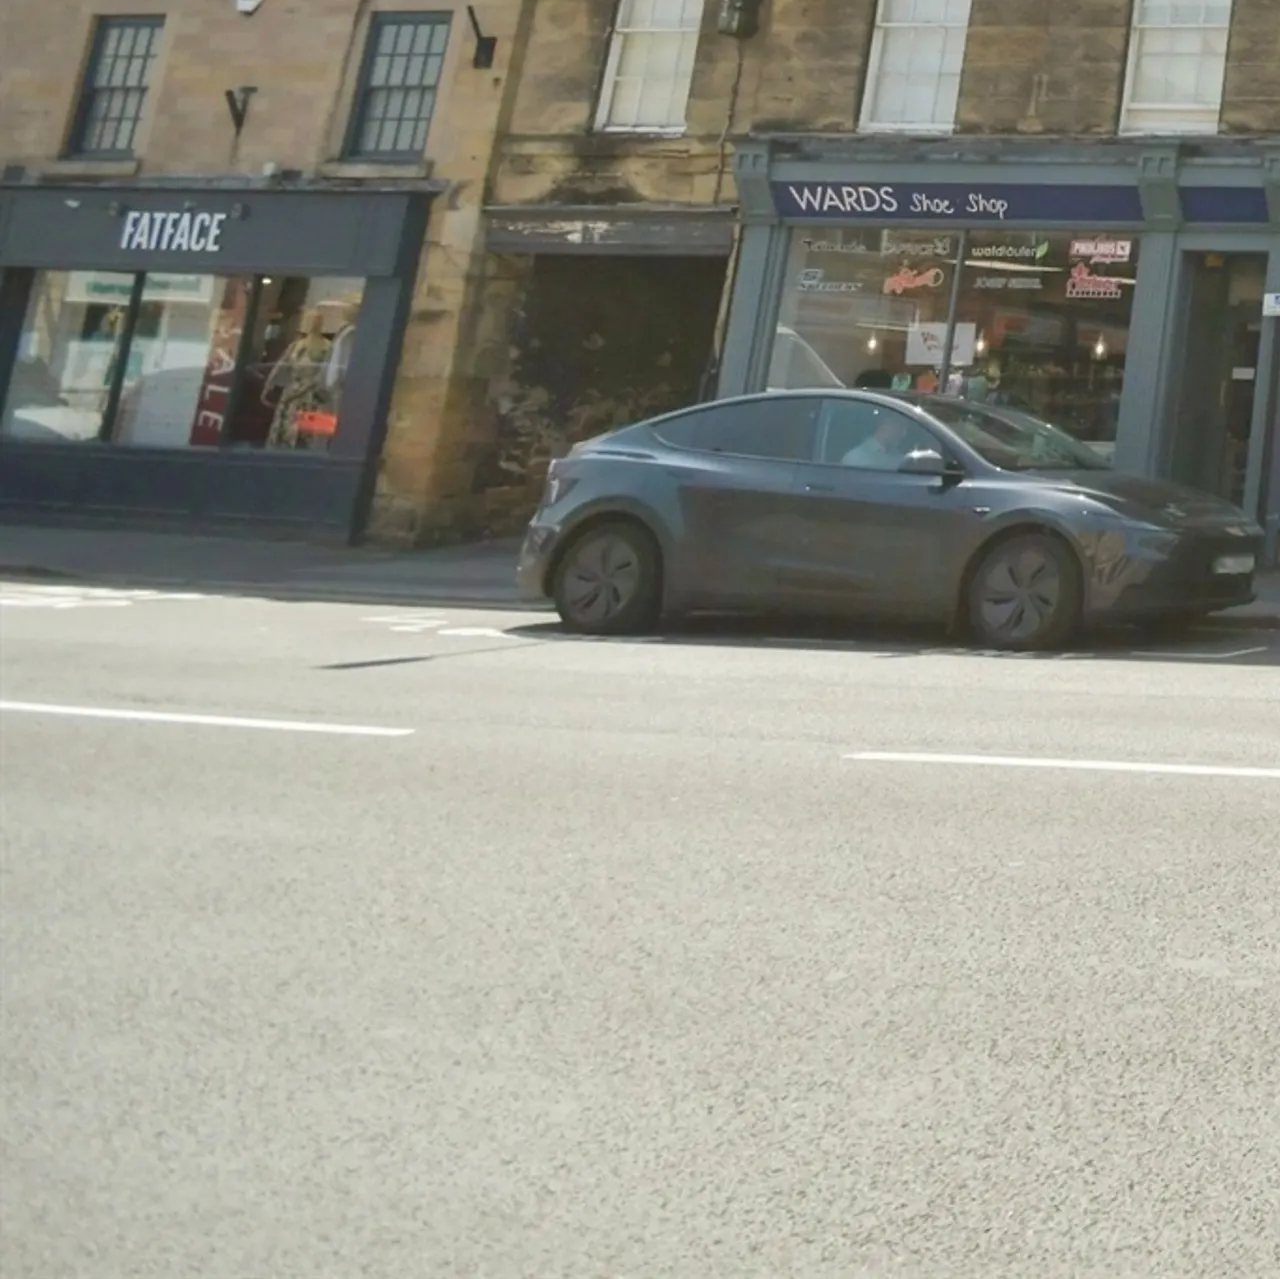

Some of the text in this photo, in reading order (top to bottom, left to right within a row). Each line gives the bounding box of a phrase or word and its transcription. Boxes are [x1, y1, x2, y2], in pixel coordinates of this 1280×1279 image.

[789, 186, 1008, 219] WARDS Shoe Shop
[120, 211, 227, 253] FATFACE
